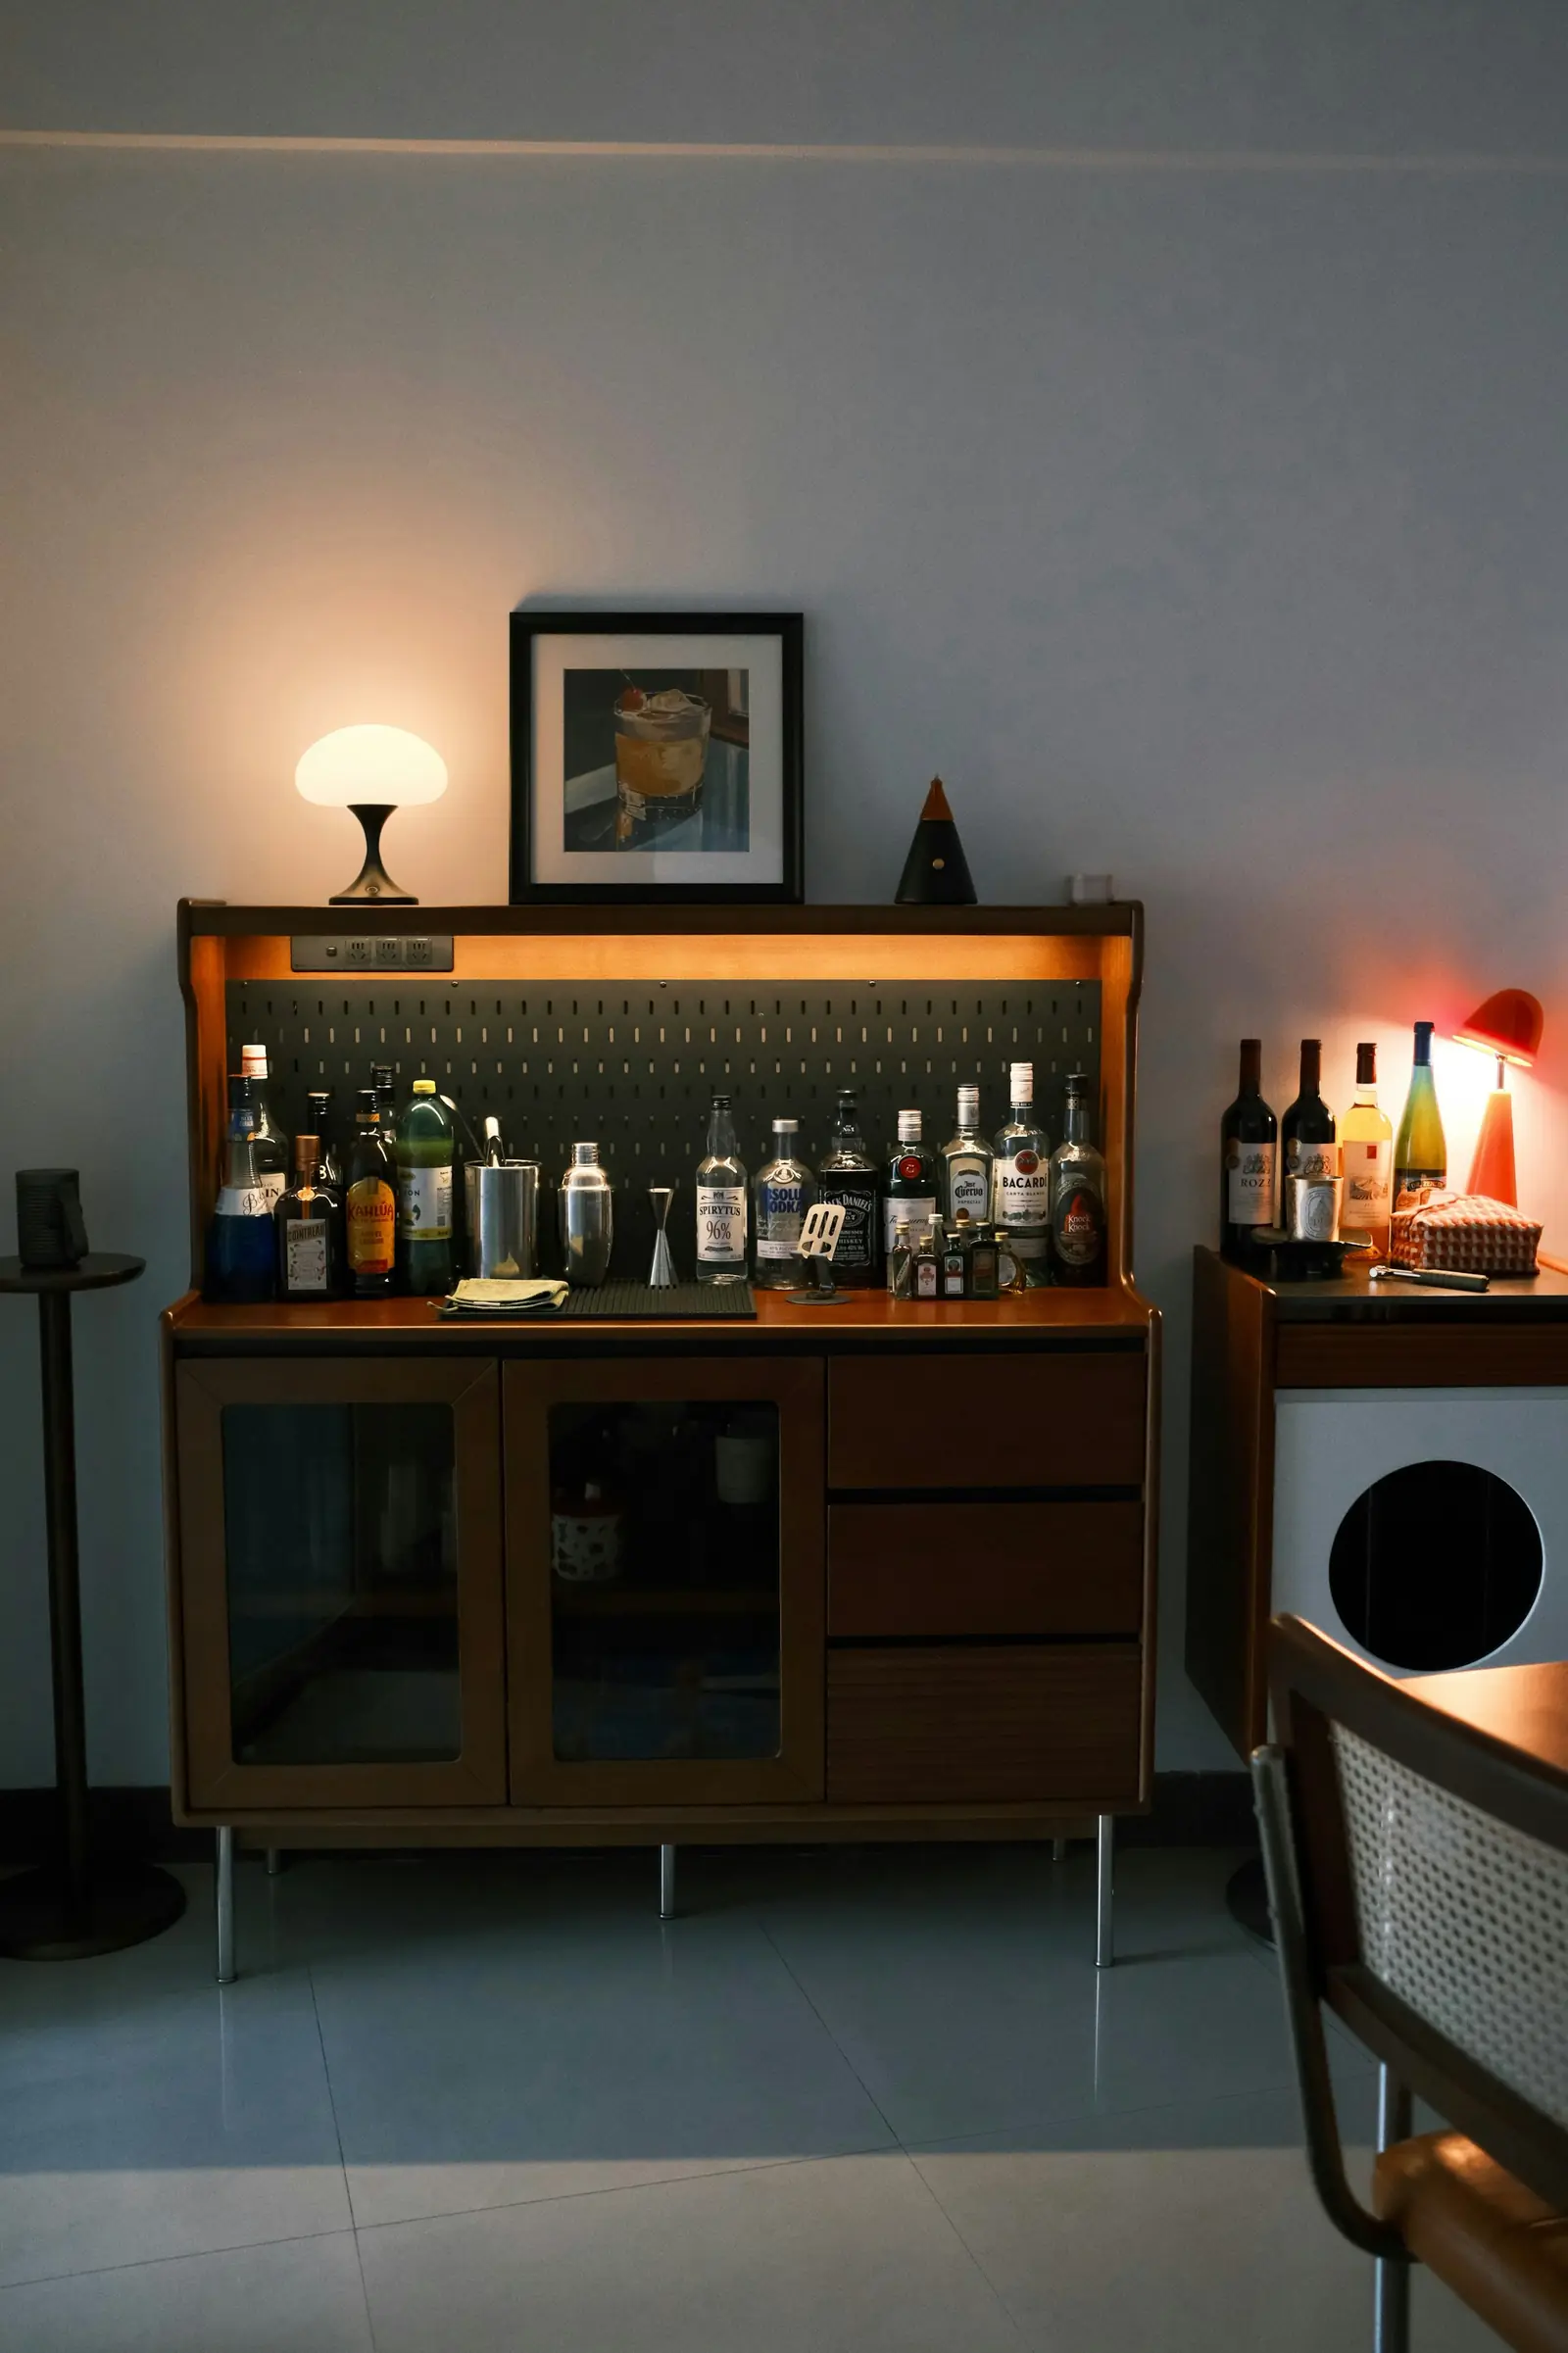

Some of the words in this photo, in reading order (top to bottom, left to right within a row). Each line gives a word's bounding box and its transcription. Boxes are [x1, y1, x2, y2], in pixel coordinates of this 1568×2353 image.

[266, 1189, 279, 1198] IN
[956, 1186, 983, 1198] Cuervo
[347, 1201, 394, 1223] KAHLÚA
[700, 1205, 741, 1216] SPIRYTUS
[1068, 1215, 1091, 1224] Knock
[707, 1220, 731, 1240] 96%
[1068, 1223, 1090, 1233] Knock
